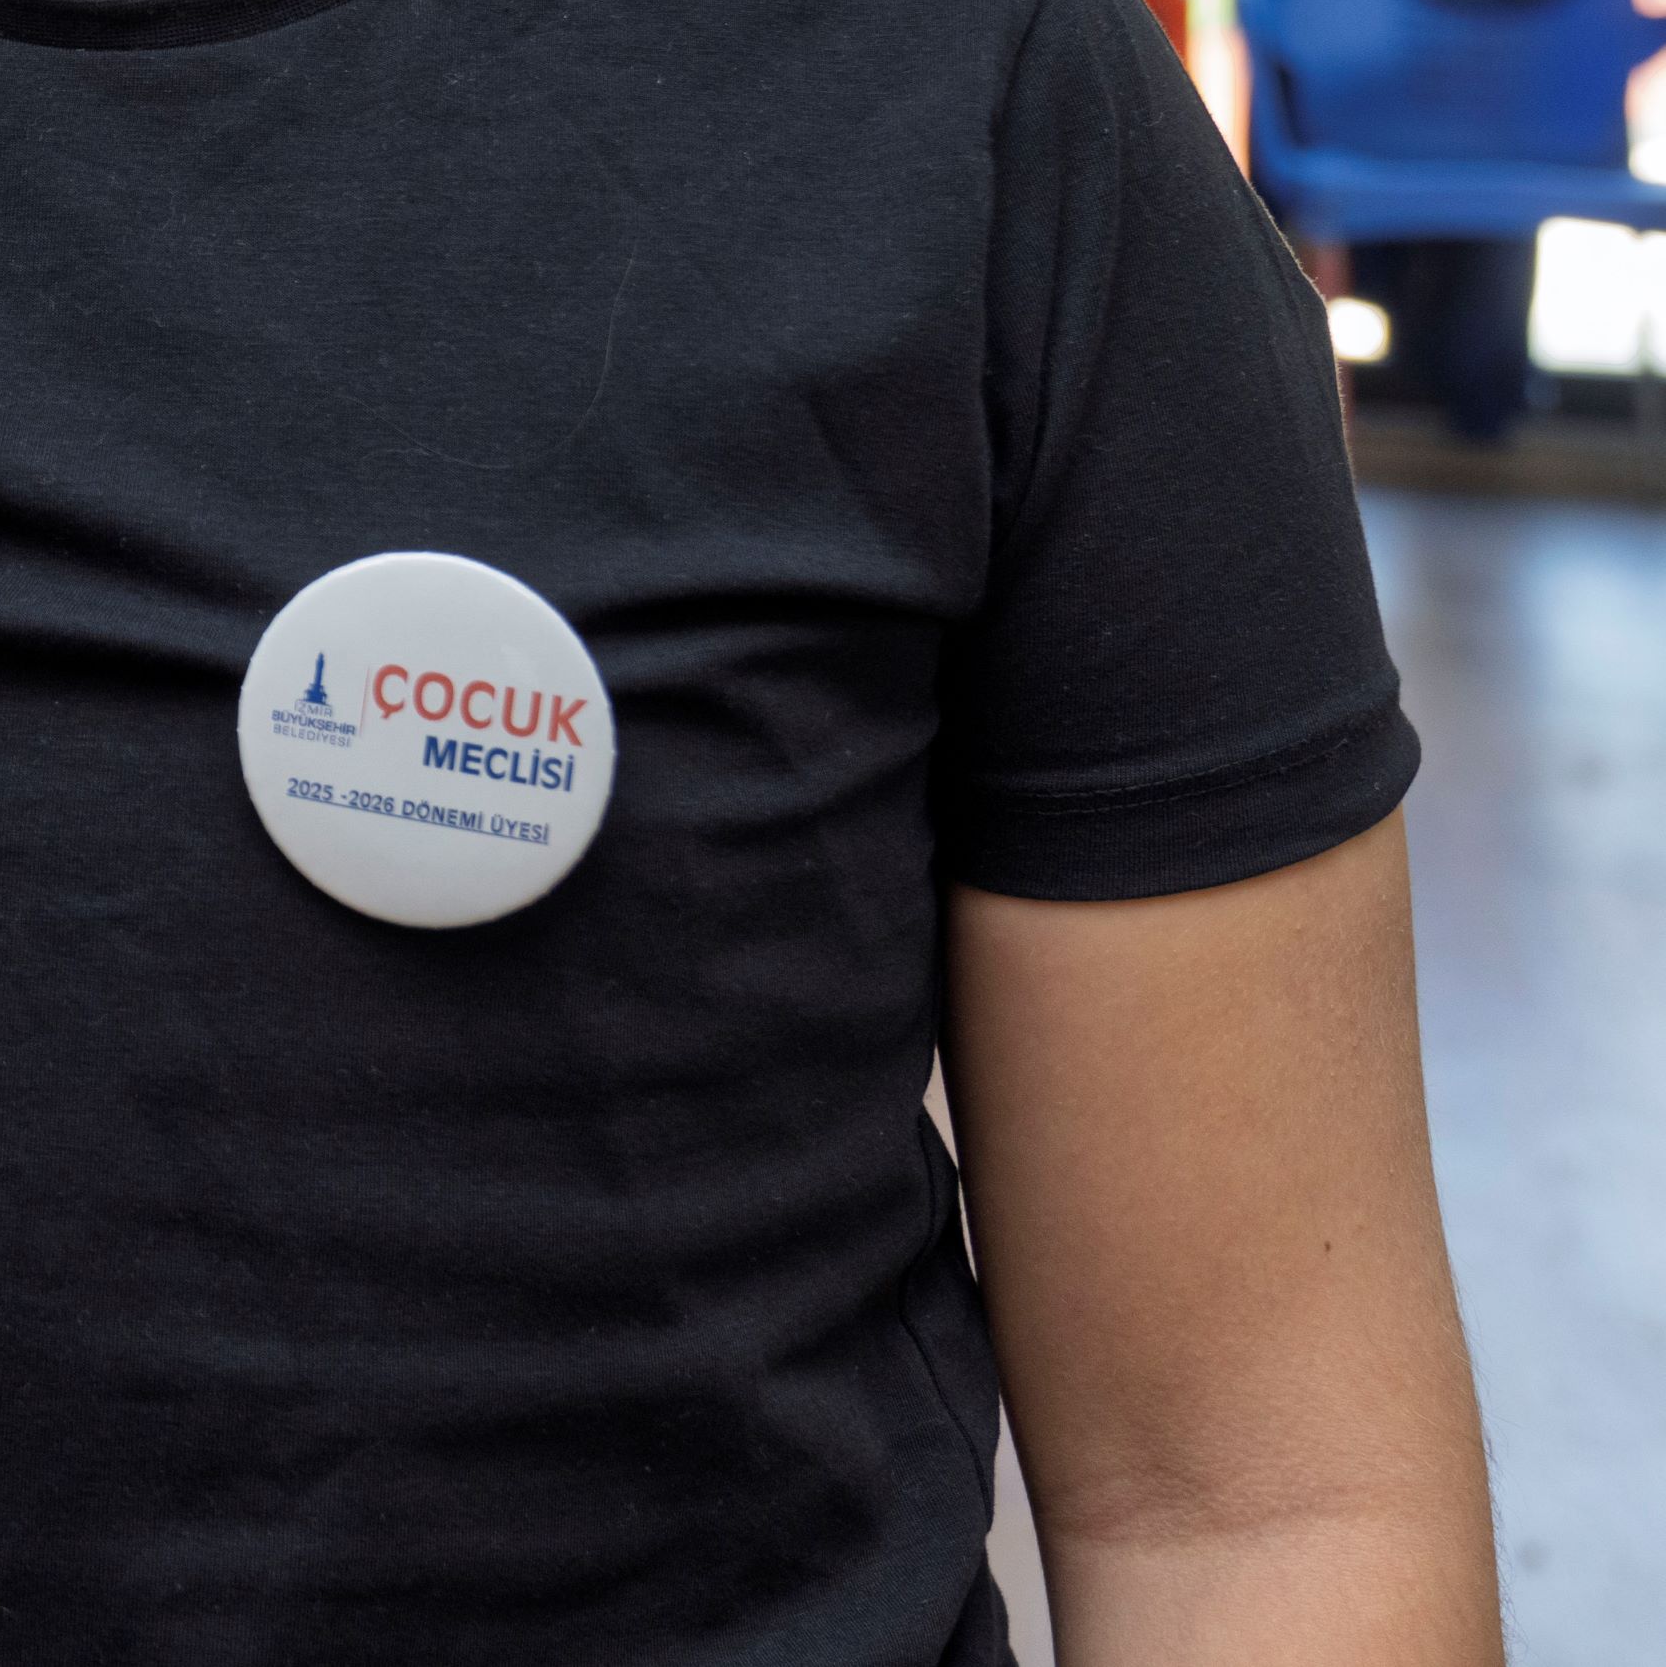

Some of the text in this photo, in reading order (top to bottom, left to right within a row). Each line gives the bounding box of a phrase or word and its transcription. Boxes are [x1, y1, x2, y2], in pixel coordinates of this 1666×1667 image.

[271, 709, 356, 736] BÜYÜKŞEHİR
[372, 663, 588, 747] ÇOCUK
[273, 724, 351, 748] BELEDİYESİ
[423, 736, 575, 792] MECLİSİ
[287, 778, 333, 801] 2025
[402, 800, 484, 831] DÖNEMİ
[490, 815, 550, 843] ÜYESİ
